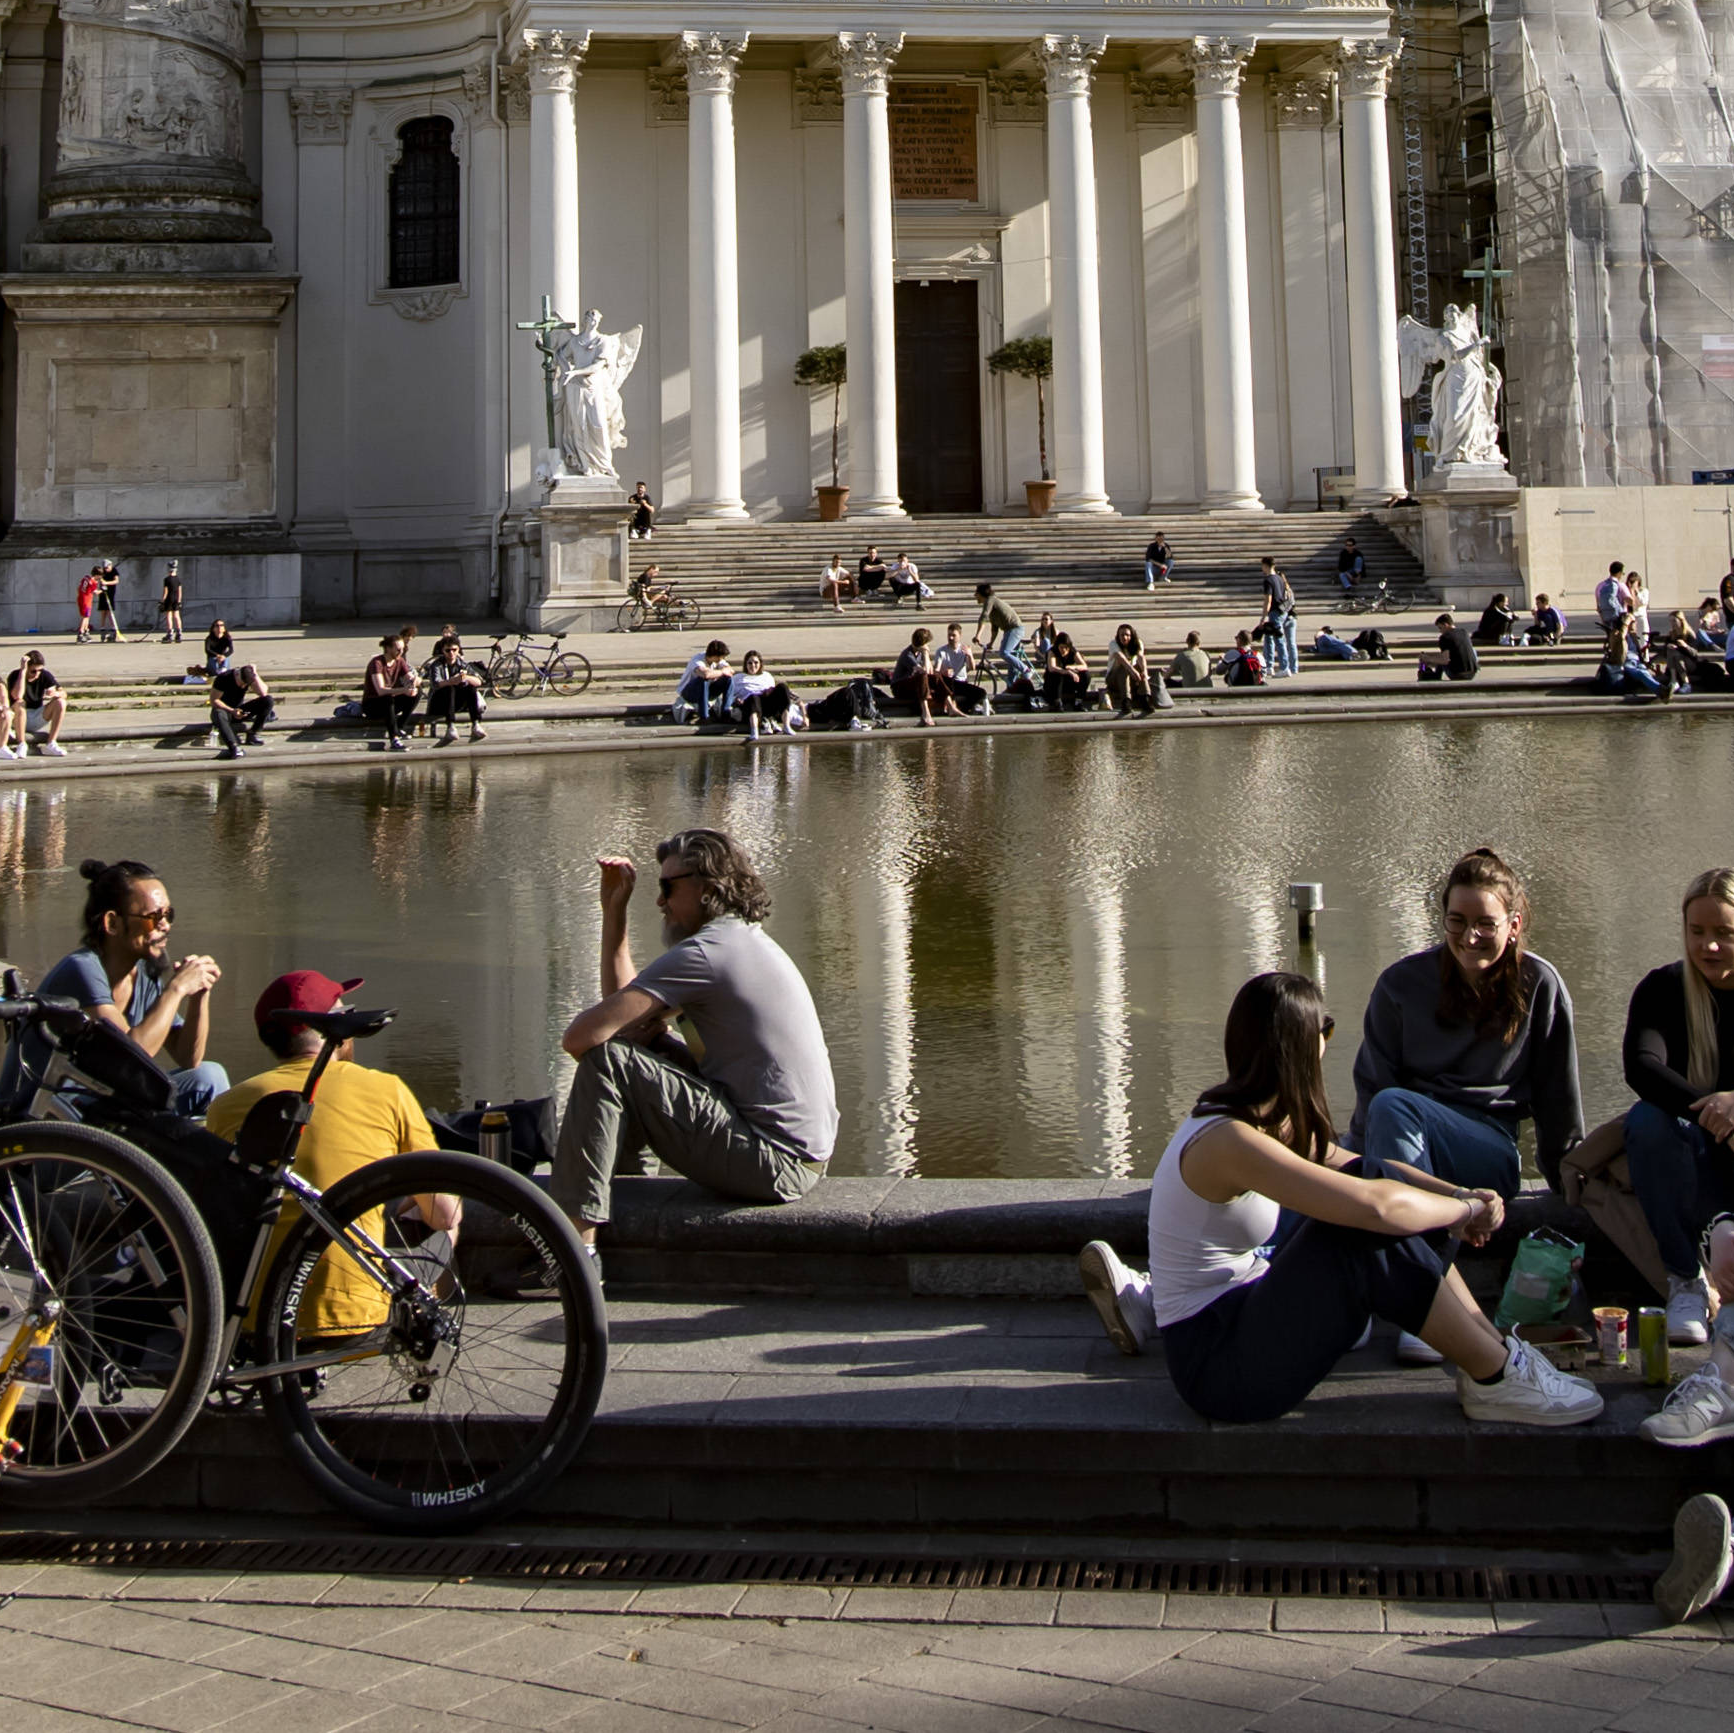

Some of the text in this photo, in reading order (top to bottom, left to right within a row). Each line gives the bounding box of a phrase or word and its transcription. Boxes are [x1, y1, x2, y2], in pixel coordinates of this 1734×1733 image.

[510, 1212, 558, 1269] WHISKY
[282, 1260, 315, 1328] WHISKY
[422, 1478, 487, 1507] WHISKY
